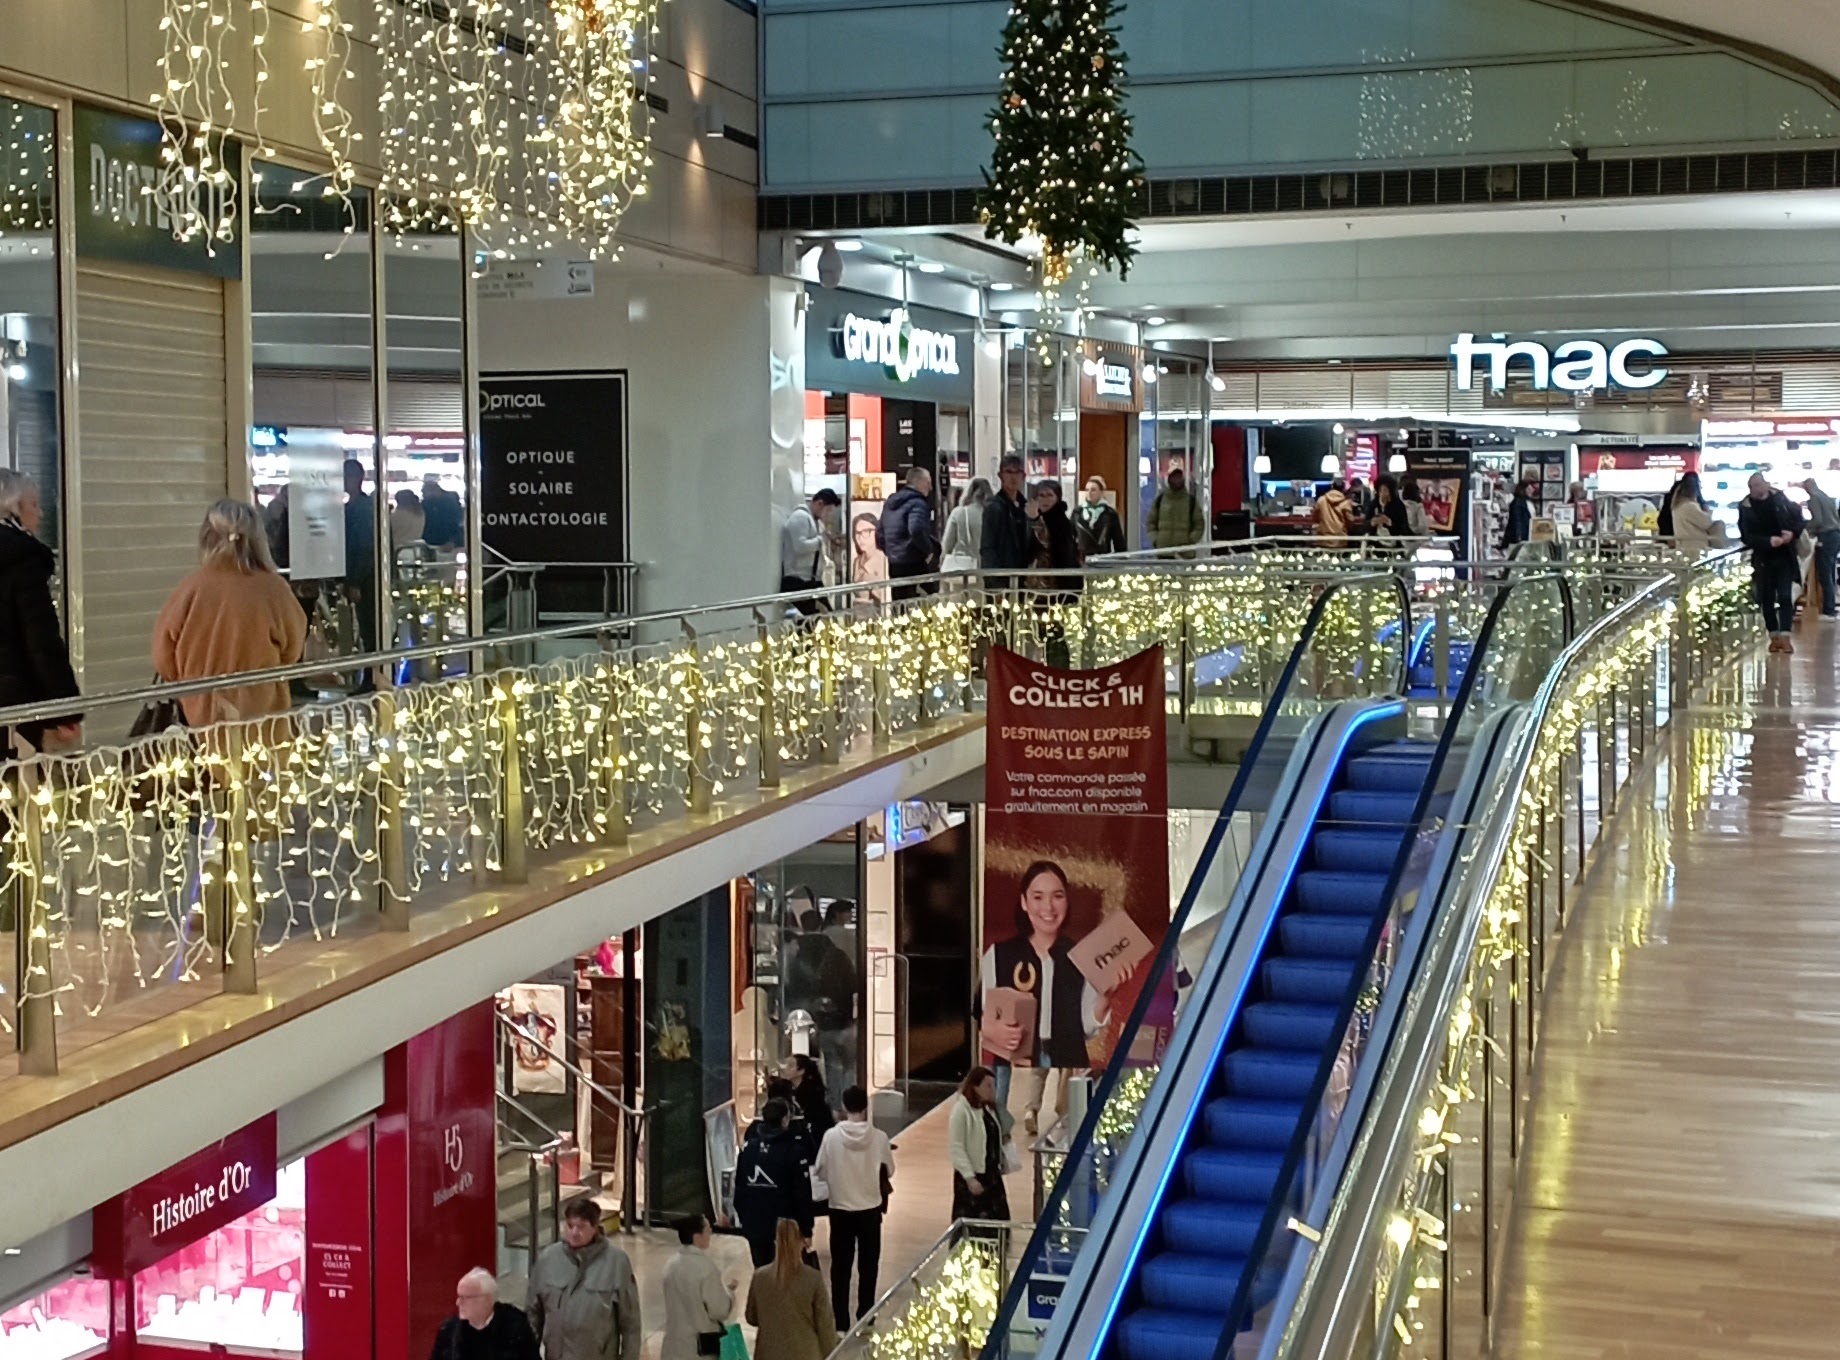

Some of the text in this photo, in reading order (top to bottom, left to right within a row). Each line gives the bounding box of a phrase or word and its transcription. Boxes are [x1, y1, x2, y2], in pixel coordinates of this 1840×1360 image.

[1450, 333, 1668, 390] fnac
[506, 451, 575, 463] OPTIQUE
[509, 482, 573, 495] SOLAIRE
[1031, 671, 1122, 691] CLICK &
[1009, 684, 1144, 708] COLLECT 1H
[1001, 726, 1151, 741] DESTINATION EXPRESS
[1024, 745, 1129, 760] SOUS LE SAPIN
[1005, 771, 1147, 785] Votre commande passée
[1010, 785, 1142, 800] sur fnac.com disponible
[1004, 800, 1149, 815] gratuitement en magasin
[1094, 937, 1131, 970] fnac
[152, 1161, 252, 1237] Histoire d'Or
